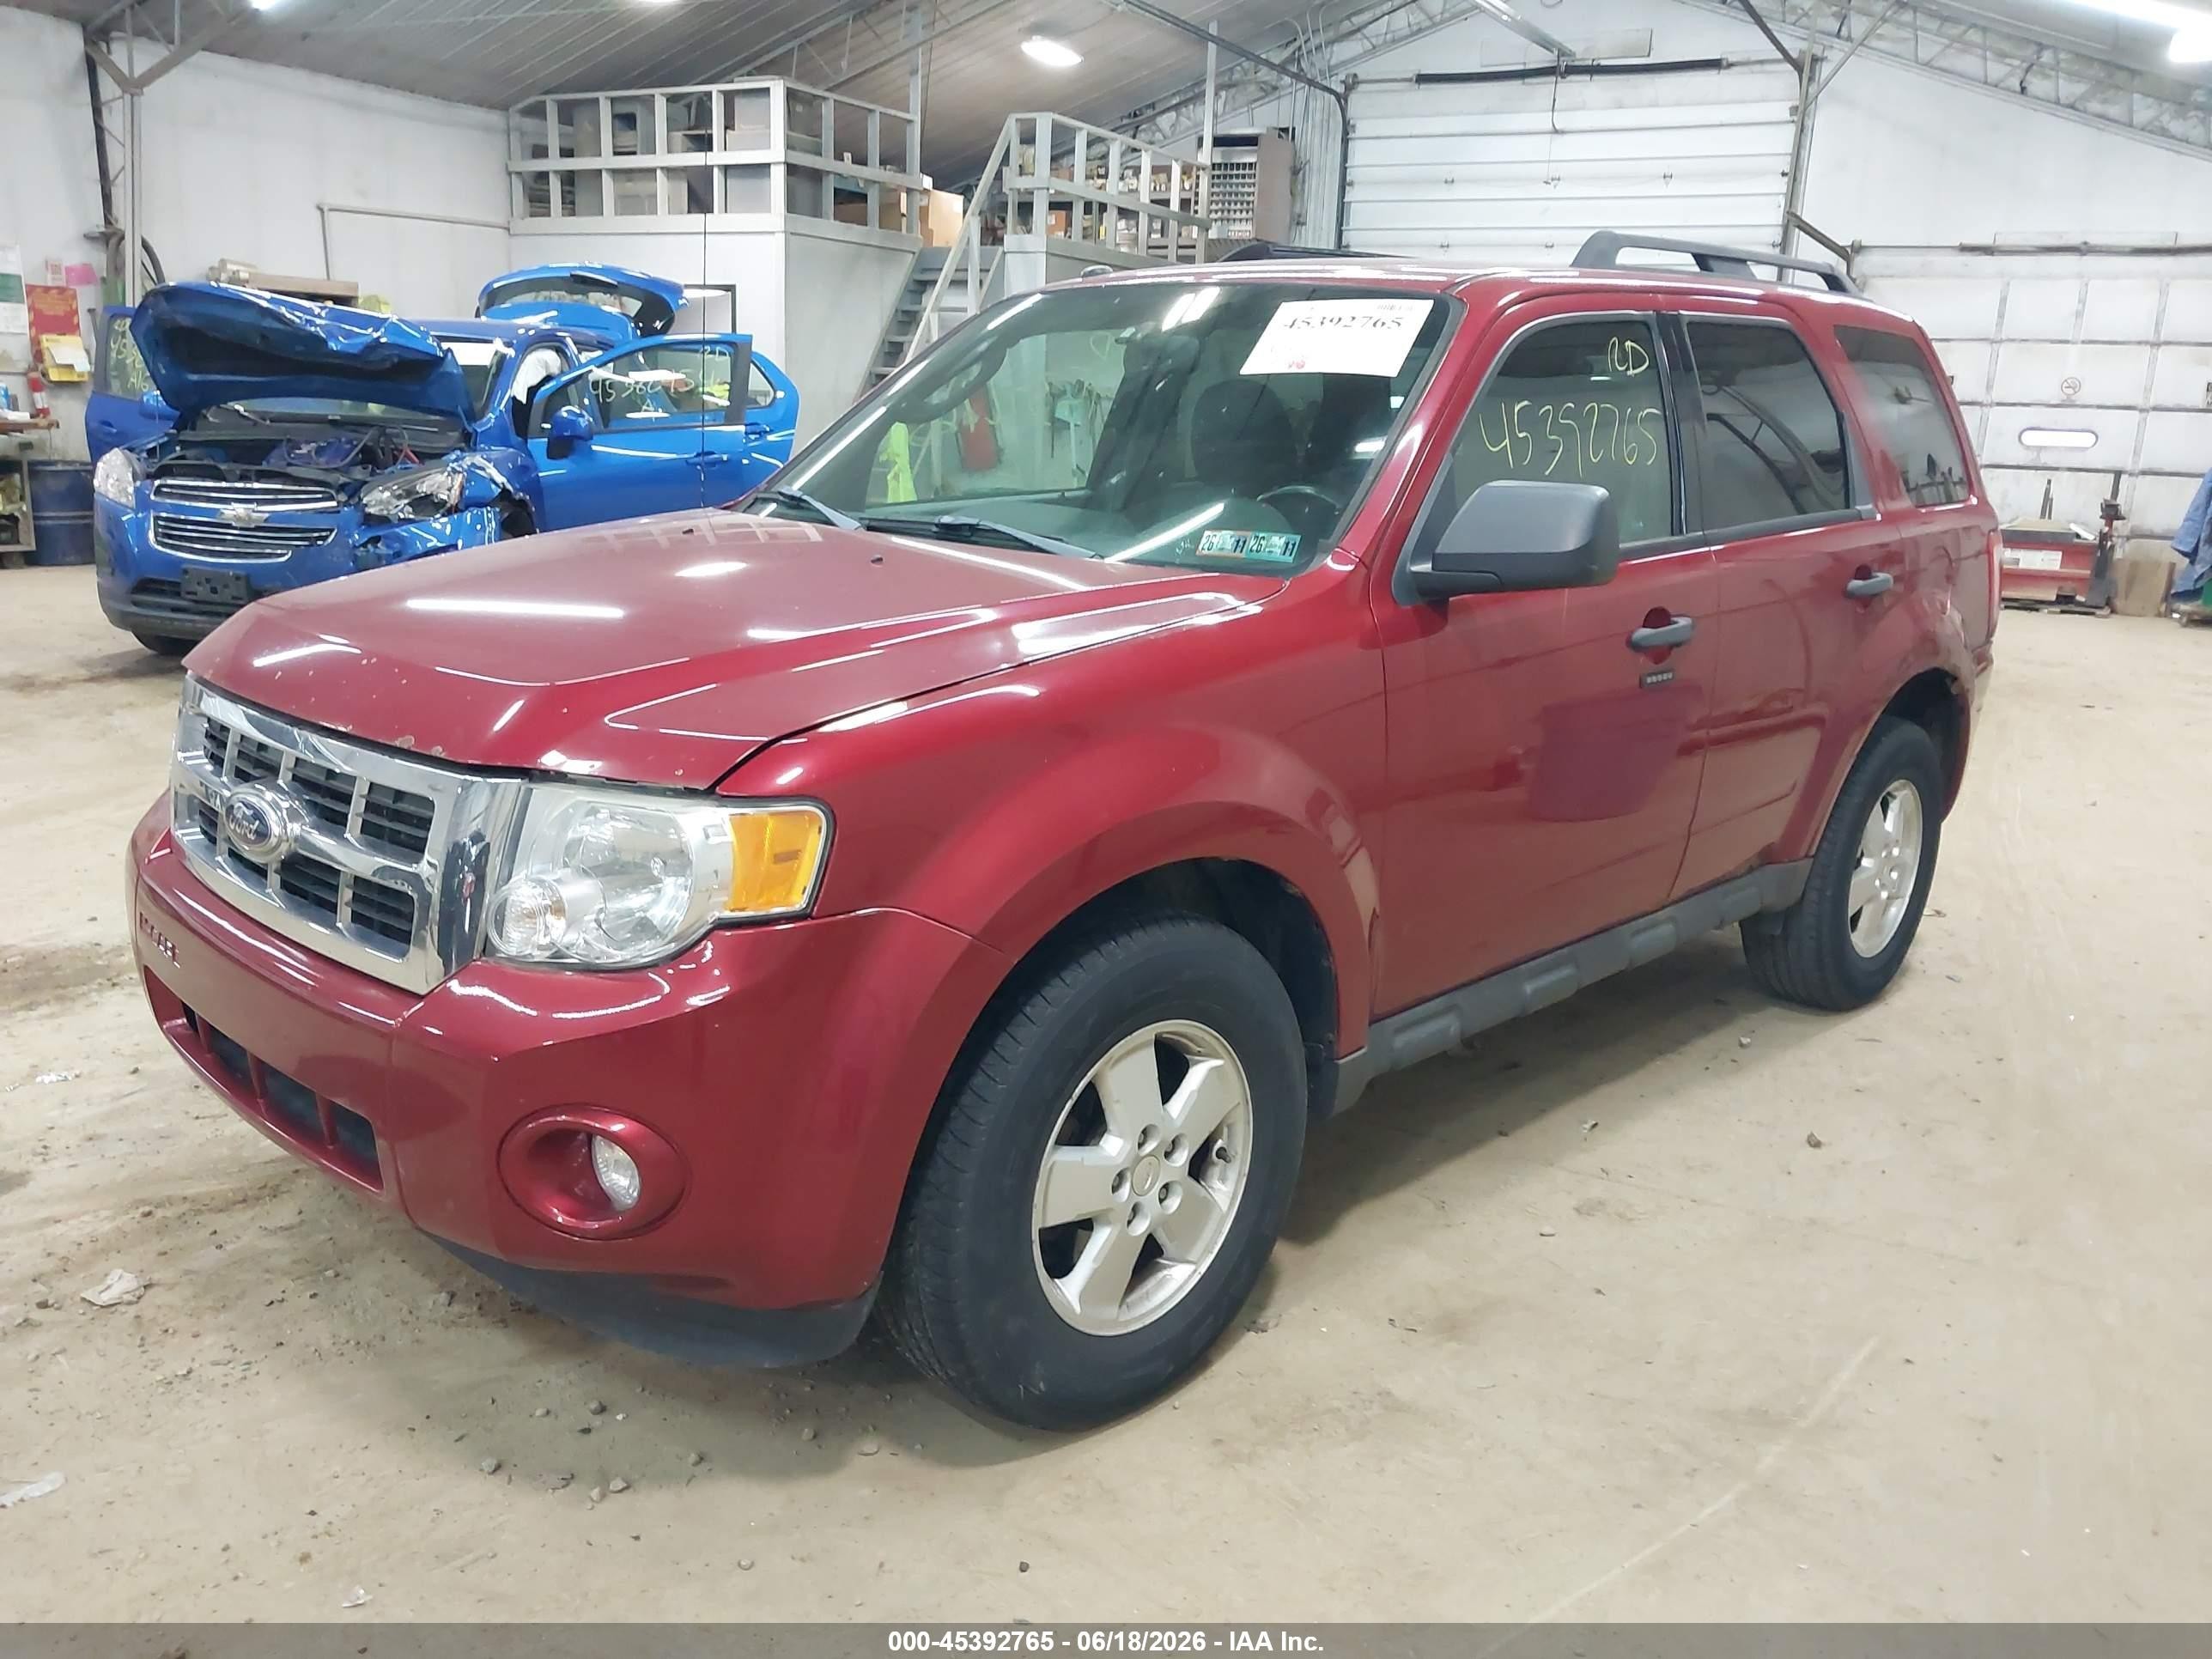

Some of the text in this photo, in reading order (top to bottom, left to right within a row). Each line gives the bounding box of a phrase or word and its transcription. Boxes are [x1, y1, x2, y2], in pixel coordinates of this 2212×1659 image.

[1284, 315, 1405, 330] 45392765
[1479, 398, 1662, 478] 45392765
[1201, 534, 1218, 551] 26
[1233, 538, 1248, 554] 11
[1249, 536, 1298, 557] 26 11
[228, 801, 260, 841] Ford
